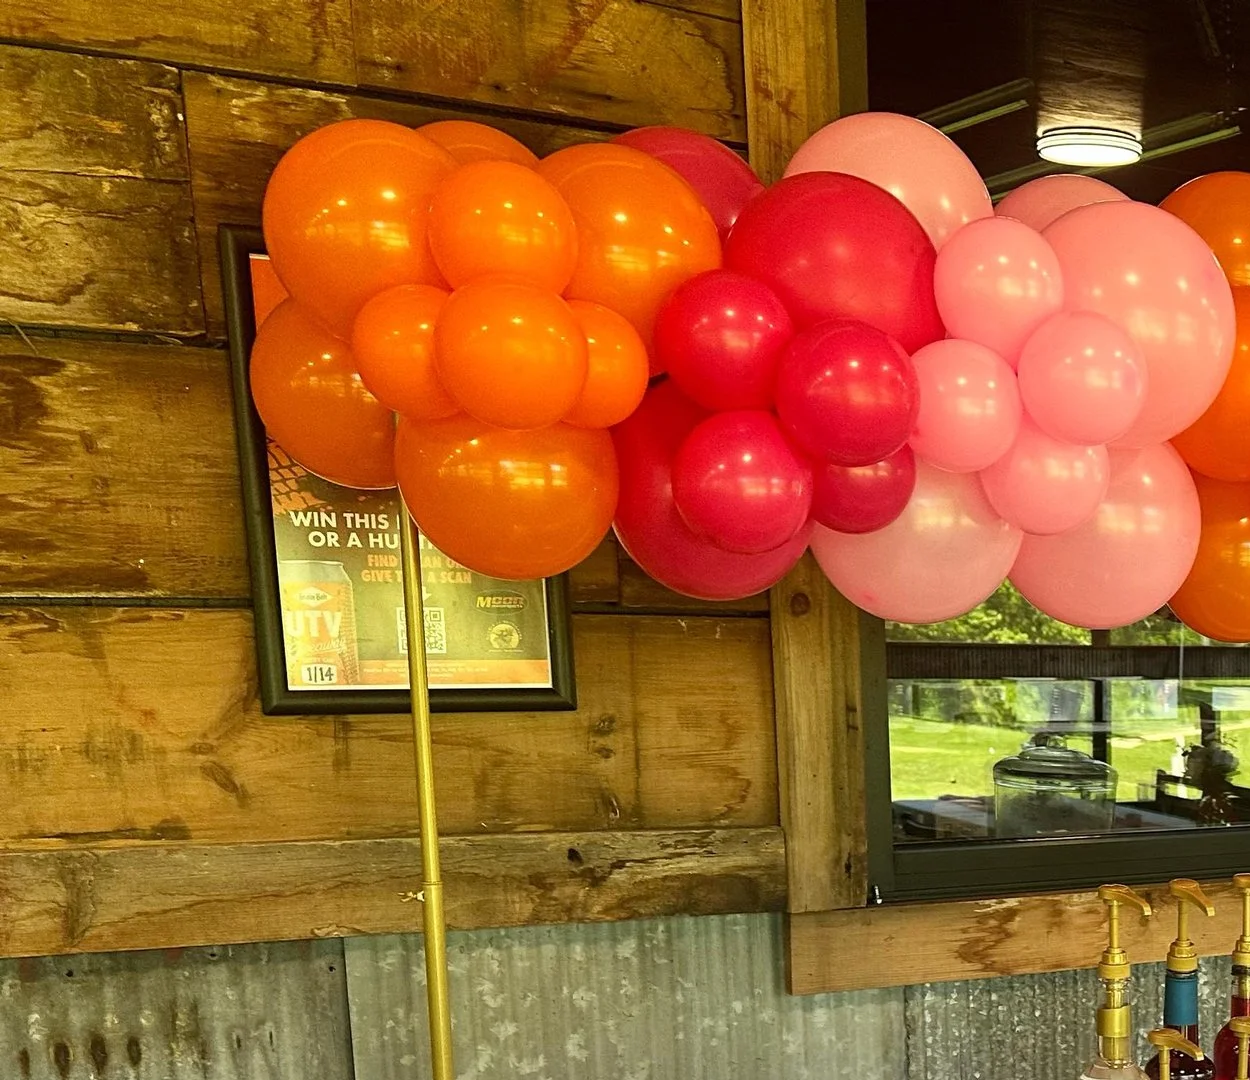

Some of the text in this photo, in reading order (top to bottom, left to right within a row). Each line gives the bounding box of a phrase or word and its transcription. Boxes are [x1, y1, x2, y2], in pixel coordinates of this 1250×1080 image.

[289, 511, 337, 528] WIN
[343, 512, 390, 529] THIS
[308, 531, 340, 548] OR
[346, 532, 364, 549] A
[367, 554, 398, 567] FIND
[361, 569, 393, 582] GIVE
[440, 571, 472, 584] SCAN
[285, 610, 342, 638] UTV
